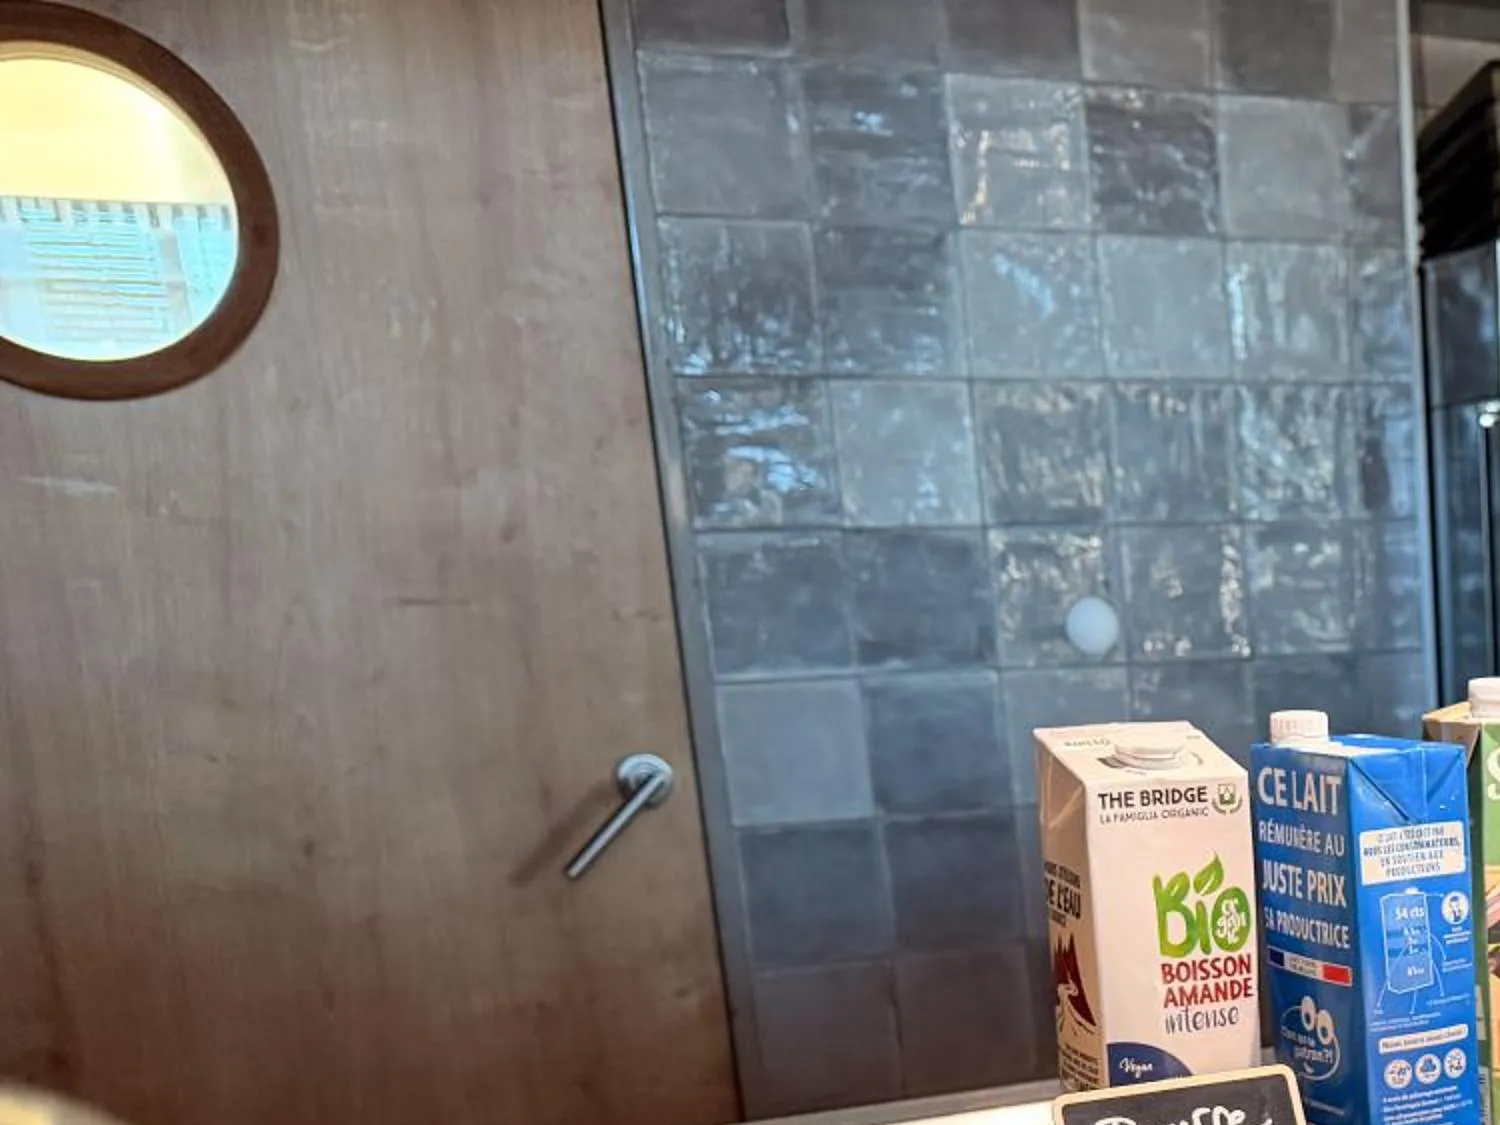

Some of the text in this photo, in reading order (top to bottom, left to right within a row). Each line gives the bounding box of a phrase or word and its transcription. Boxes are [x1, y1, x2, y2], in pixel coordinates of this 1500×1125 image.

[1097, 786, 1208, 810] THE BRIDGE
[1257, 767, 1342, 816] CE LAIT
[1099, 806, 1209, 825] LA FAMIGLIA ORGANIC
[1323, 833, 1345, 857] AU
[1262, 860, 1348, 908] JUSTE PRIX
[1276, 909, 1350, 949] PRODUCTRICE
[1161, 953, 1253, 984] BOISSON
[1163, 977, 1254, 1009] AMANDE
[1165, 1006, 1239, 1035] intense
[1119, 1057, 1154, 1079] Vegan
